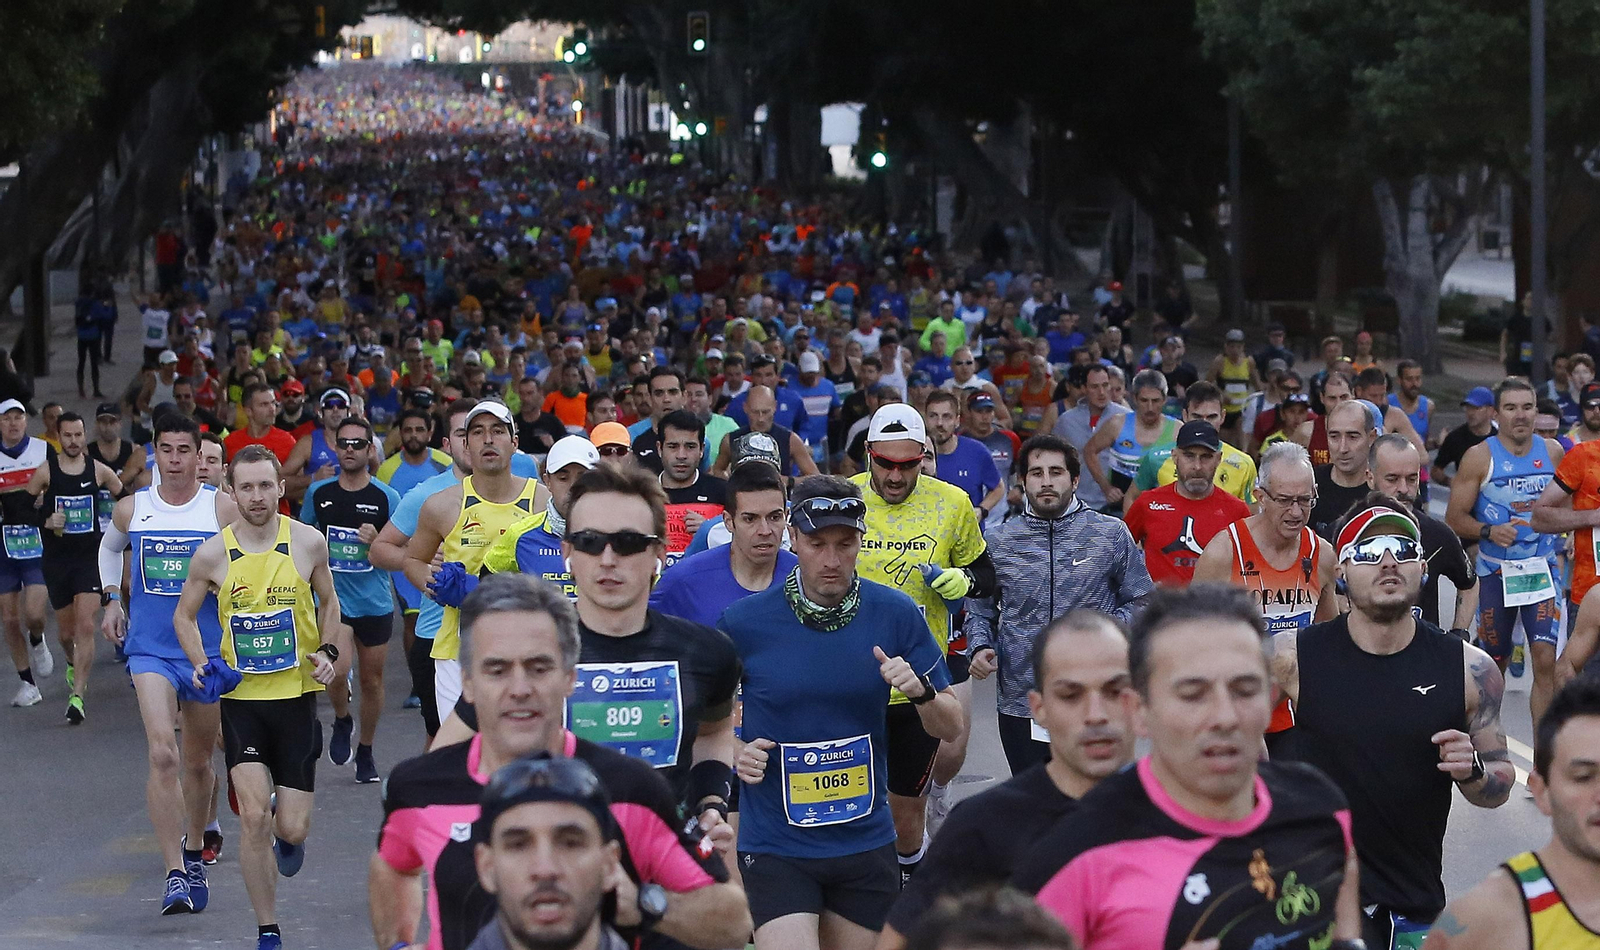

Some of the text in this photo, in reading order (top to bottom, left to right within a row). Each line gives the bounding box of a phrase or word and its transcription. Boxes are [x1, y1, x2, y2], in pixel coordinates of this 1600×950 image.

[342, 545, 359, 555] 629
[860, 540, 927, 551] EEN POWER
[162, 560, 182, 571] 756
[1252, 588, 1313, 606] OBARRA
[254, 619, 280, 628] ZURICH
[1271, 621, 1299, 629] ZURICH
[252, 636, 274, 648] 657
[612, 677, 657, 689] ZURICH
[605, 706, 643, 727] 809
[819, 749, 854, 761] ZURICH
[812, 773, 849, 790] 1068
